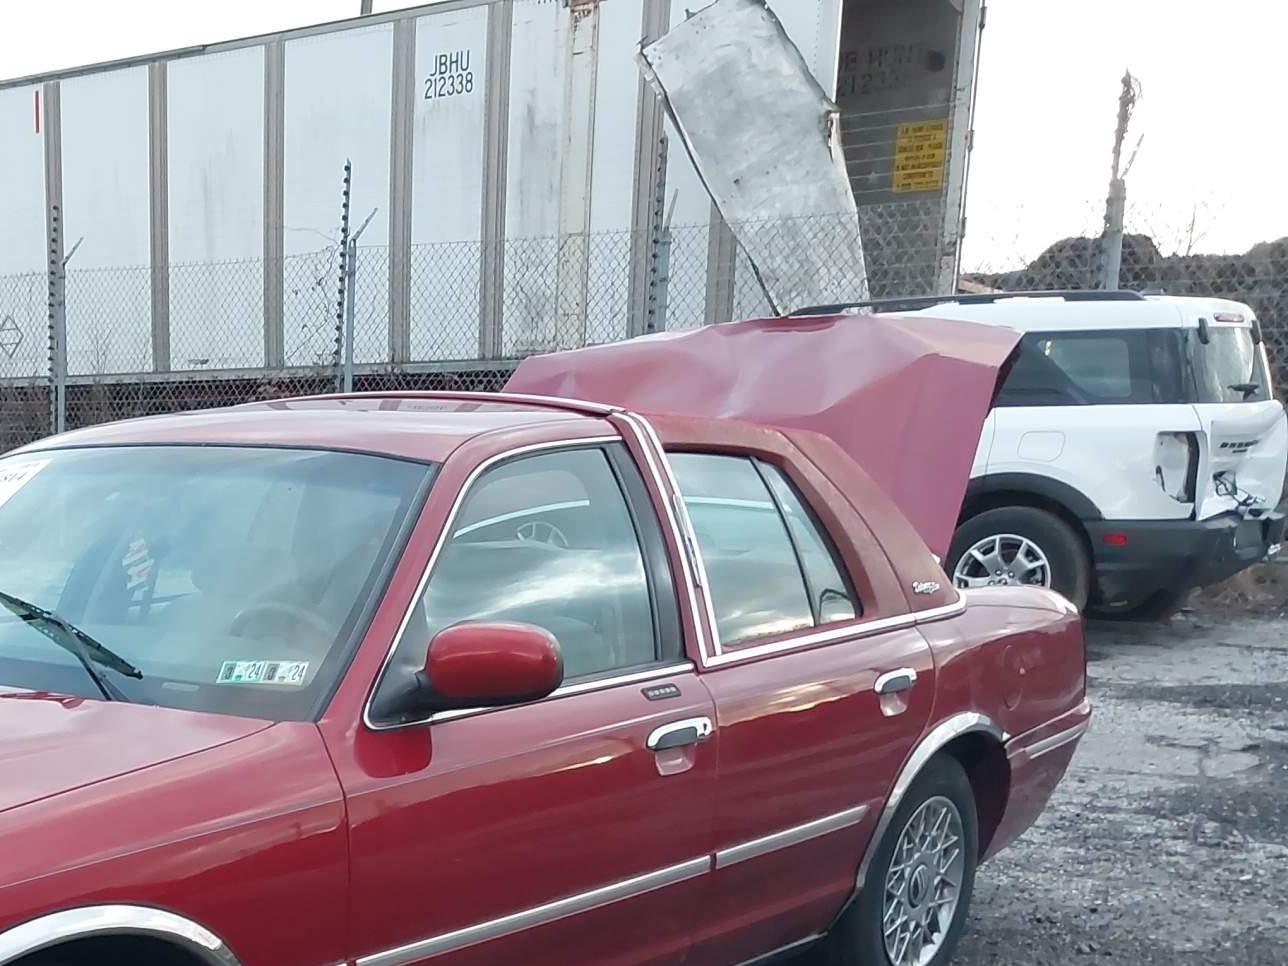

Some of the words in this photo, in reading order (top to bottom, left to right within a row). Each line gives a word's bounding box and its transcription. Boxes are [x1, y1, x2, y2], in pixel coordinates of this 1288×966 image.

[429, 49, 470, 77] JBHU
[424, 71, 474, 99] 212338
[247, 663, 262, 680] 24
[291, 664, 306, 681] 24
